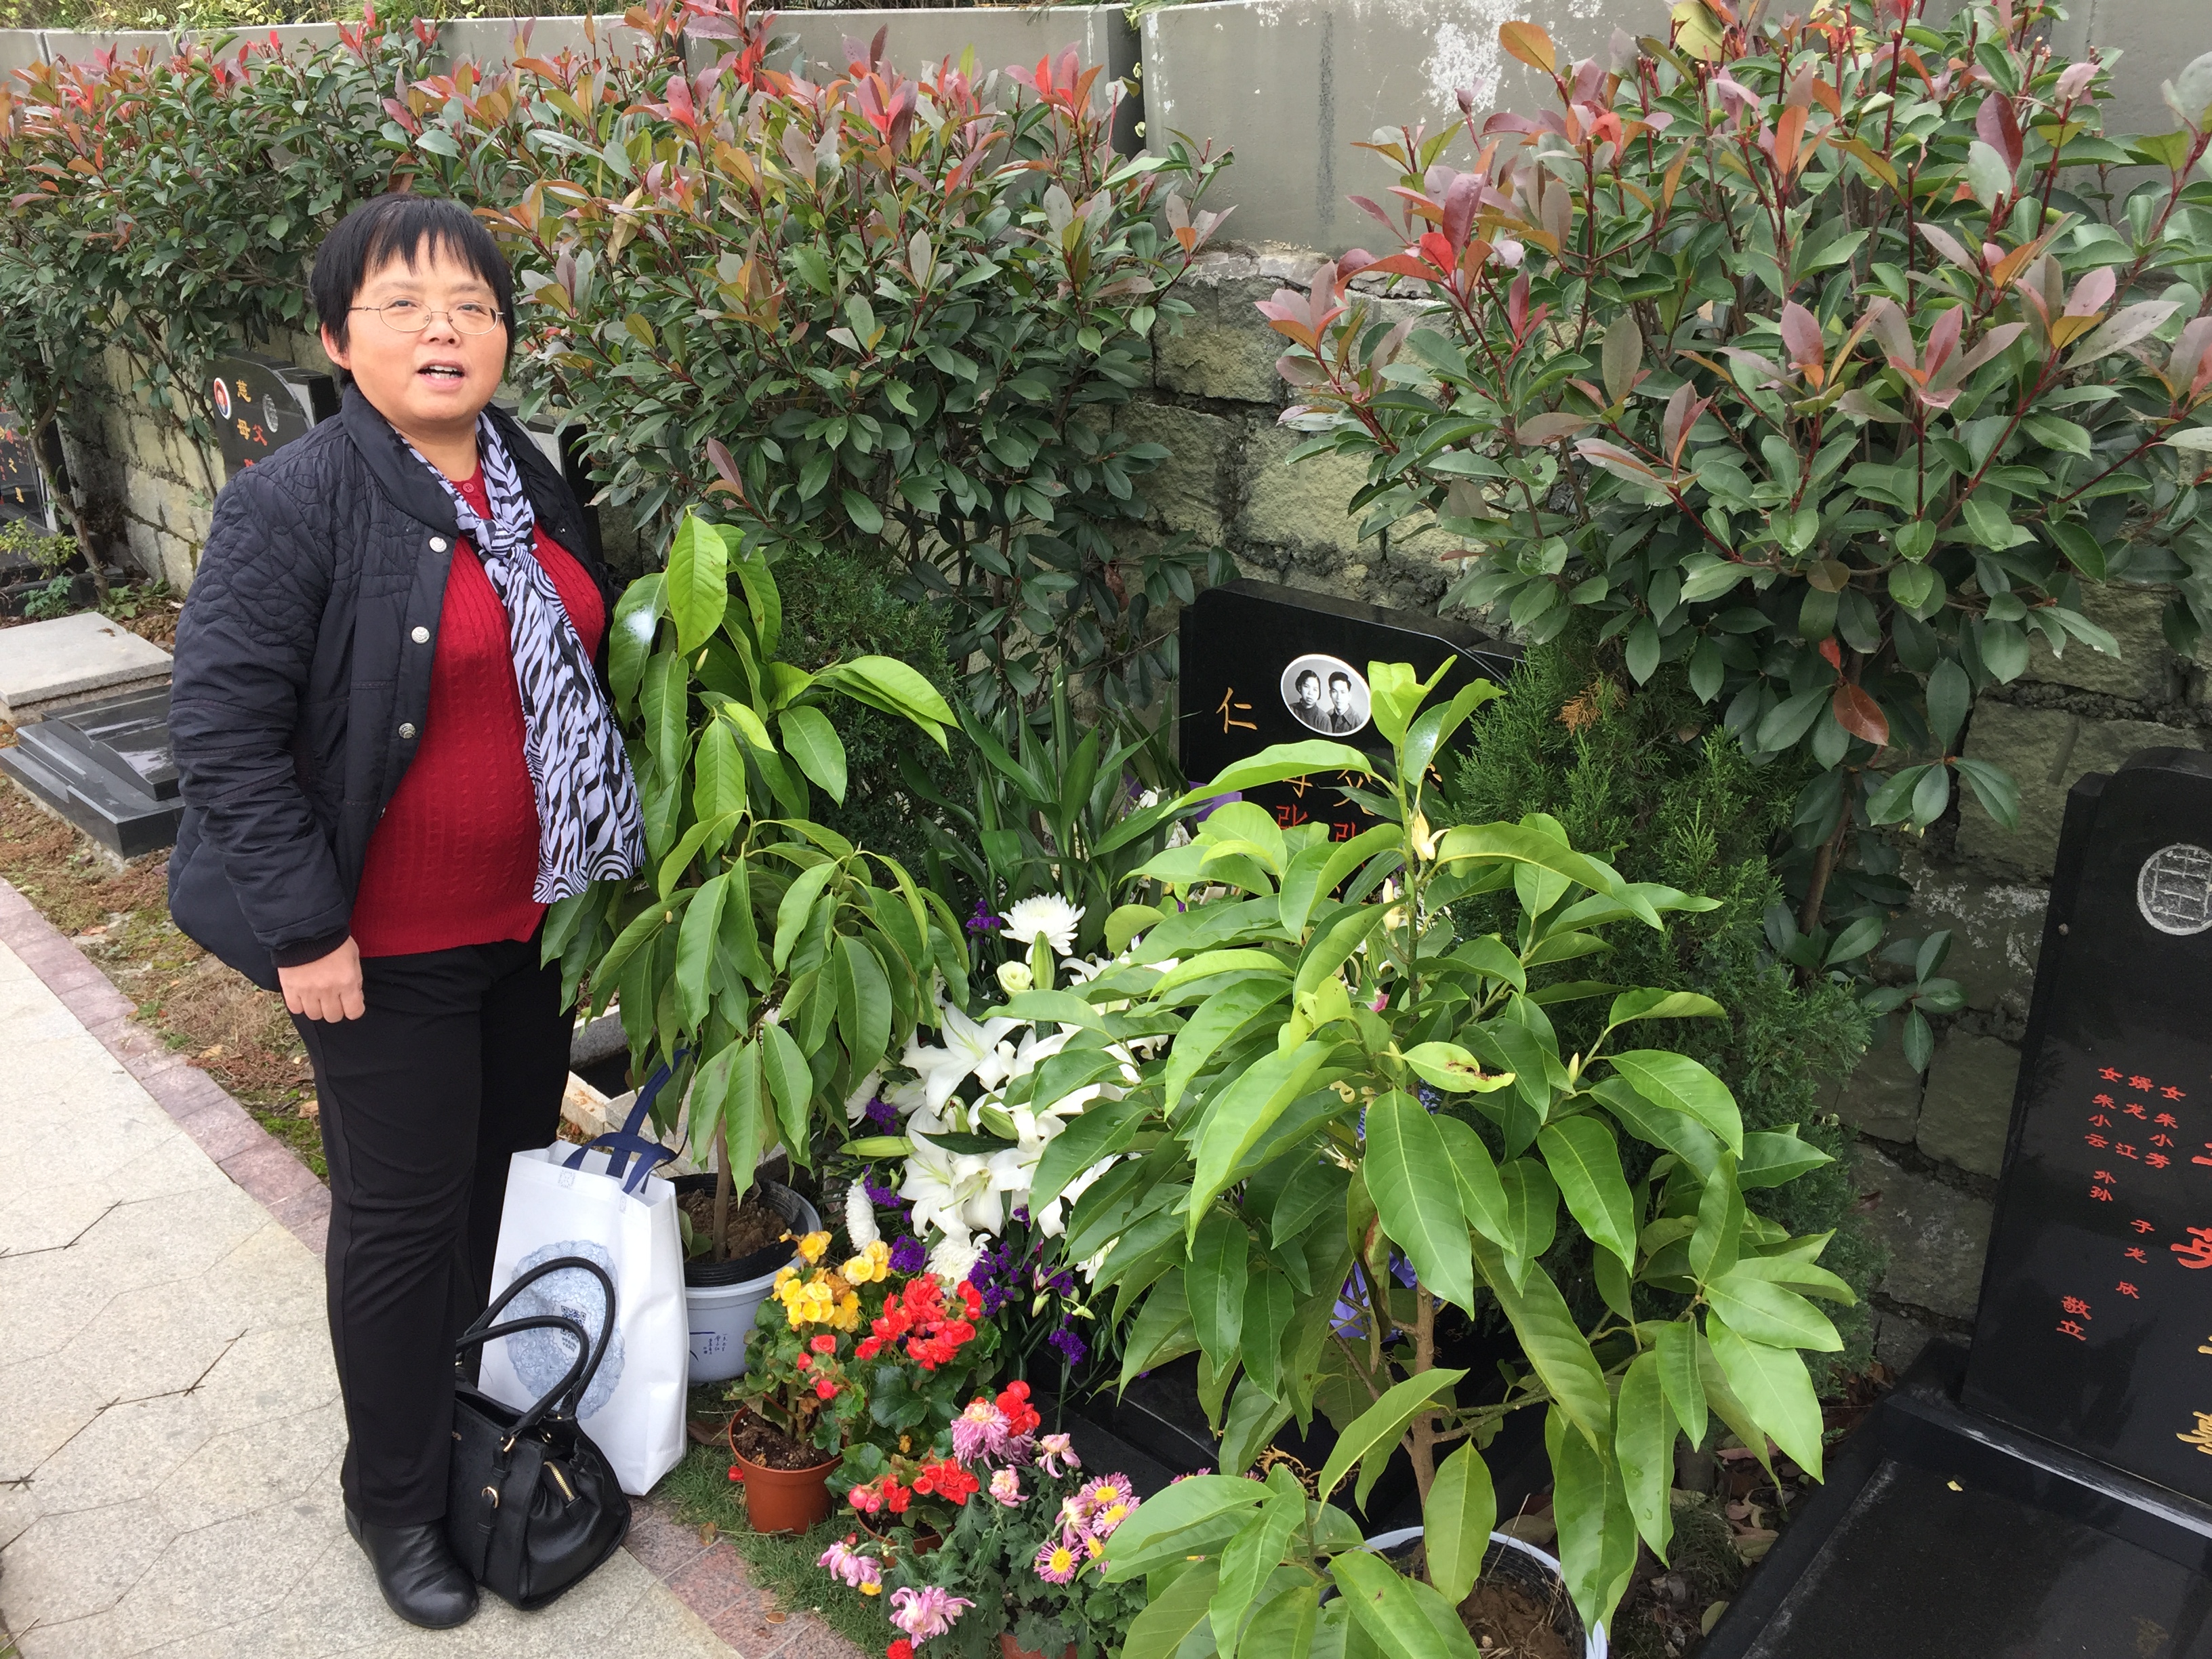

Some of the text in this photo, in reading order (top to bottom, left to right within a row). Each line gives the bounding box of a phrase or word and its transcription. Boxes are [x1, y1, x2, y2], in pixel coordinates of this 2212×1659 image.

[237, 418, 251, 440] 母
[1216, 687, 1258, 733] 仁
[2085, 1067, 2123, 1153] 女朱小云
[2056, 1296, 2092, 1341] 敬立
